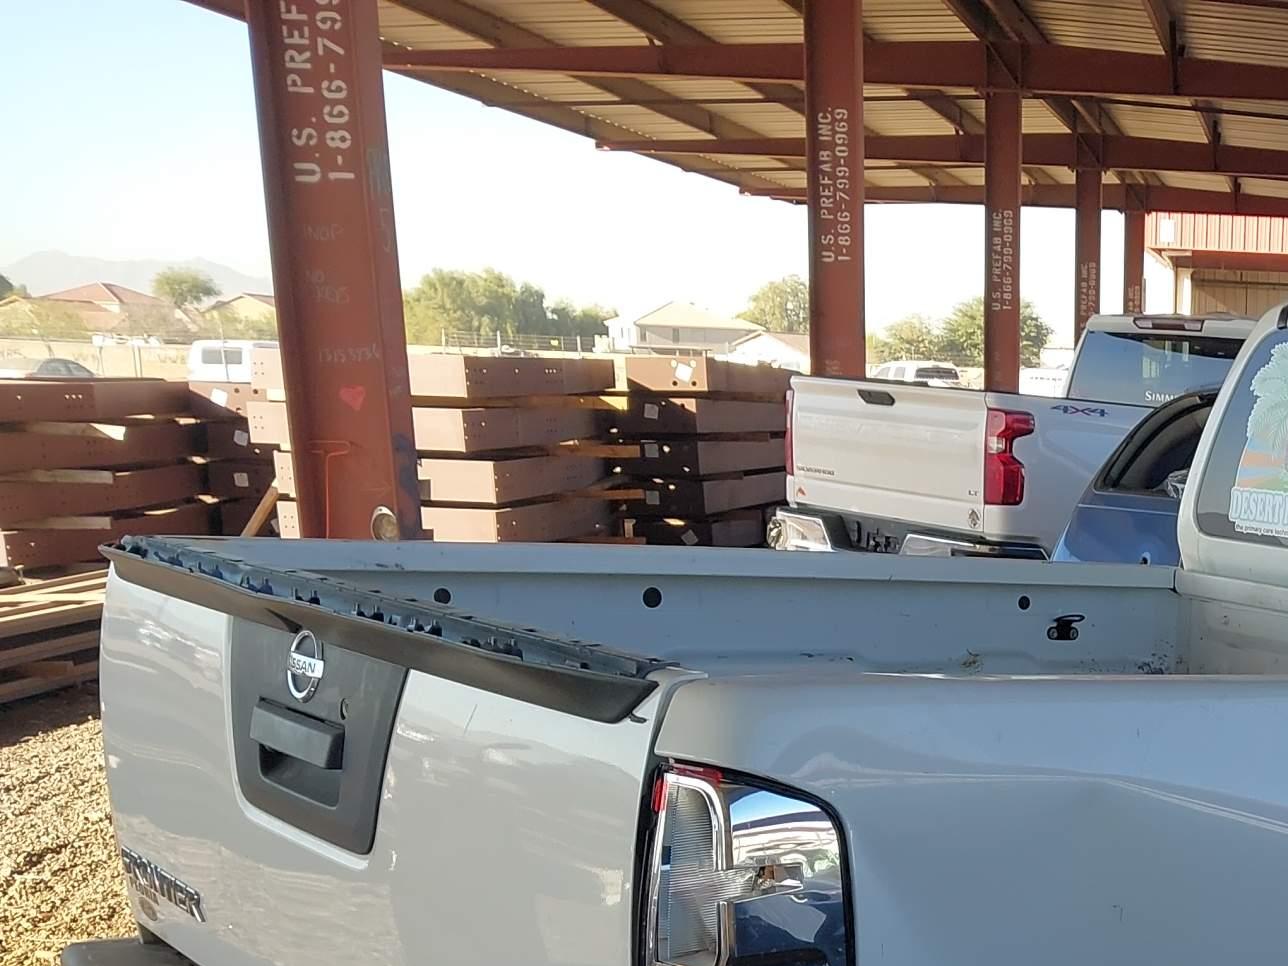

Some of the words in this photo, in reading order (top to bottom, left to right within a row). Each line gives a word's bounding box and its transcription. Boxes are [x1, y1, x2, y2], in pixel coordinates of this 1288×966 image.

[315, 0, 355, 180] 1-866-79
[817, 107, 832, 140] INC.
[291, 116, 322, 183] U.S.
[819, 150, 834, 219] PREFAB
[834, 108, 851, 262] 1-866-799-0969
[821, 229, 835, 263] U.S.
[1144, 390, 1180, 403] SIMM
[1231, 490, 1283, 525] DESERT
